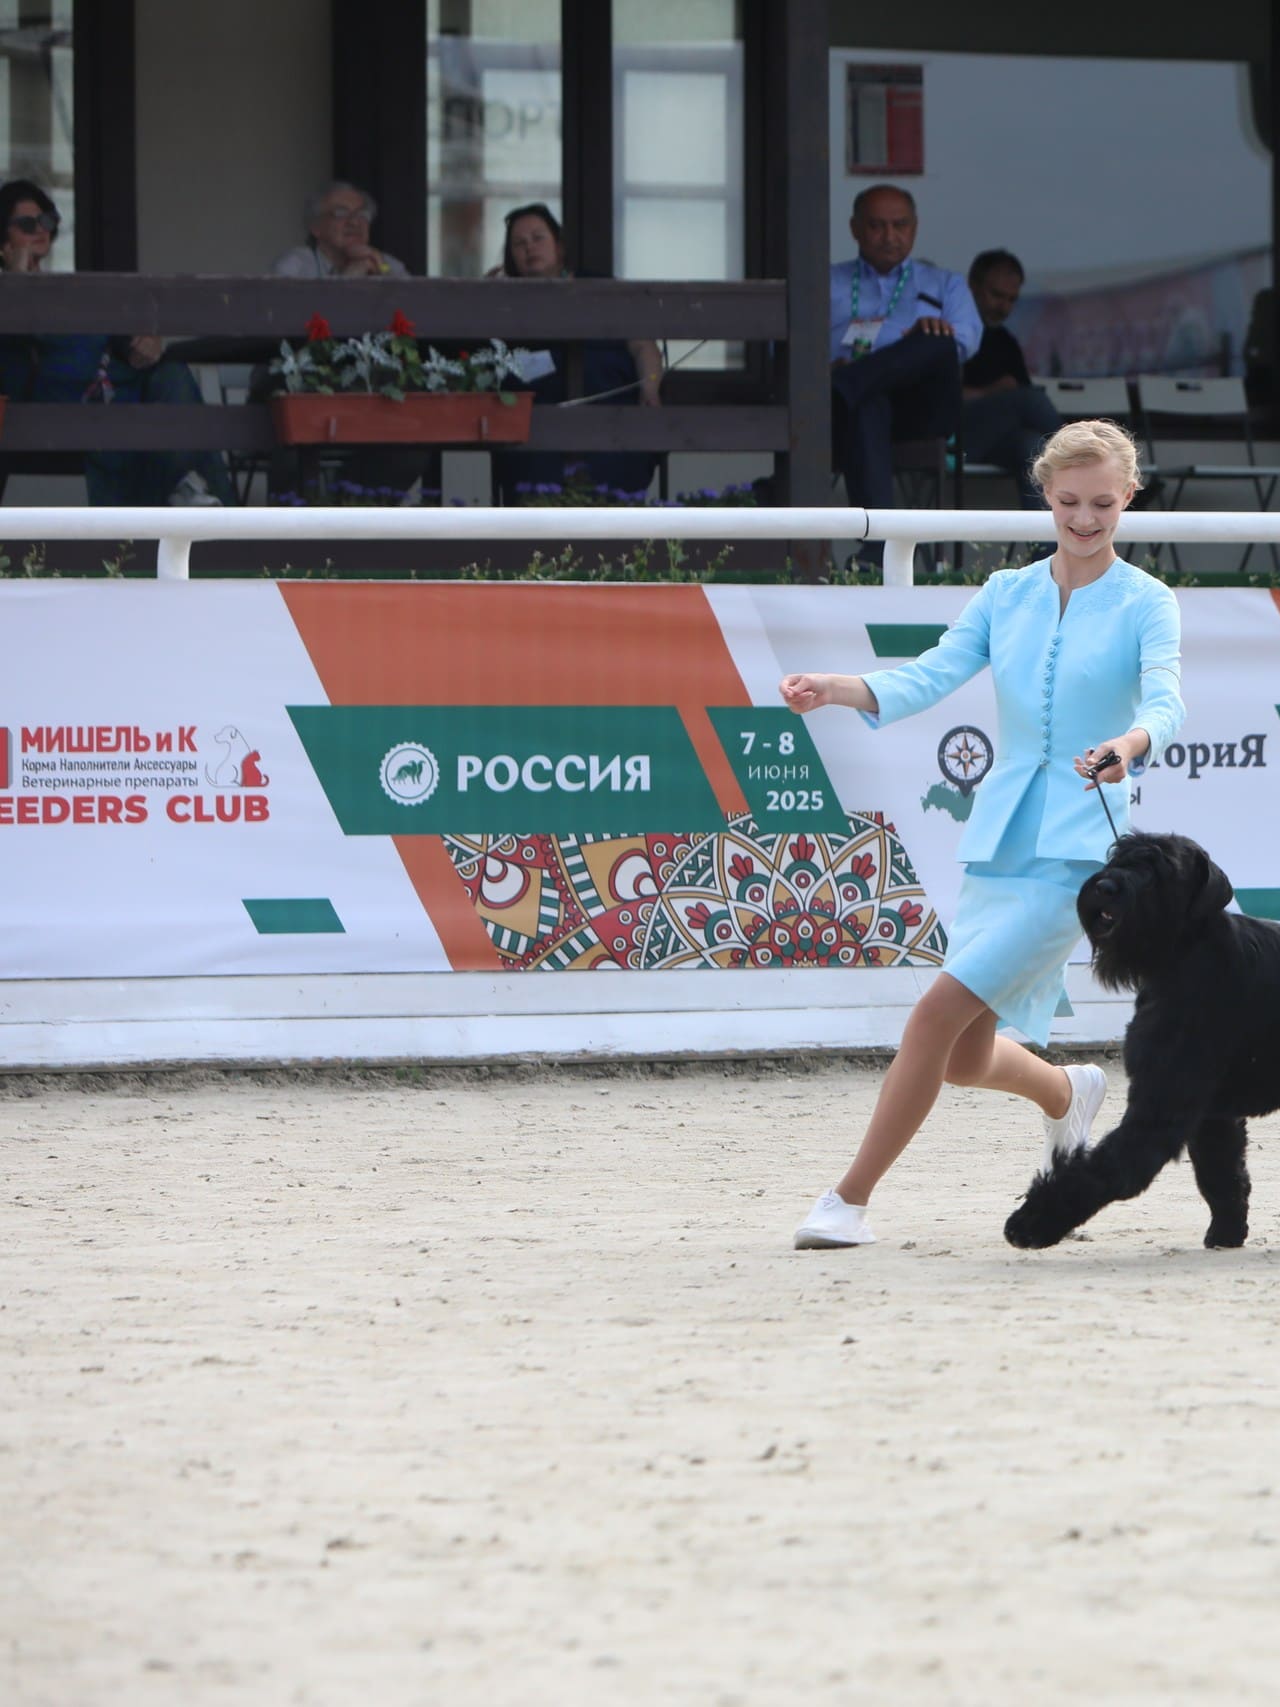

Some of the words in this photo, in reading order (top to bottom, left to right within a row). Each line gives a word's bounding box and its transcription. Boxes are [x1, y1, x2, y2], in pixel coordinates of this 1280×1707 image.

[21, 726, 152, 753] МИШЕЛЬ
[179, 726, 199, 753] К
[22, 759, 57, 773] Корма
[60, 759, 131, 772] Наполнители
[134, 758, 198, 773] Аксессуары
[457, 755, 650, 793] РОССИЯ
[22, 776, 122, 791] Ветеринарные
[125, 777, 199, 791] препараты
[166, 795, 270, 823] CLUB
[766, 791, 824, 811] 2025
